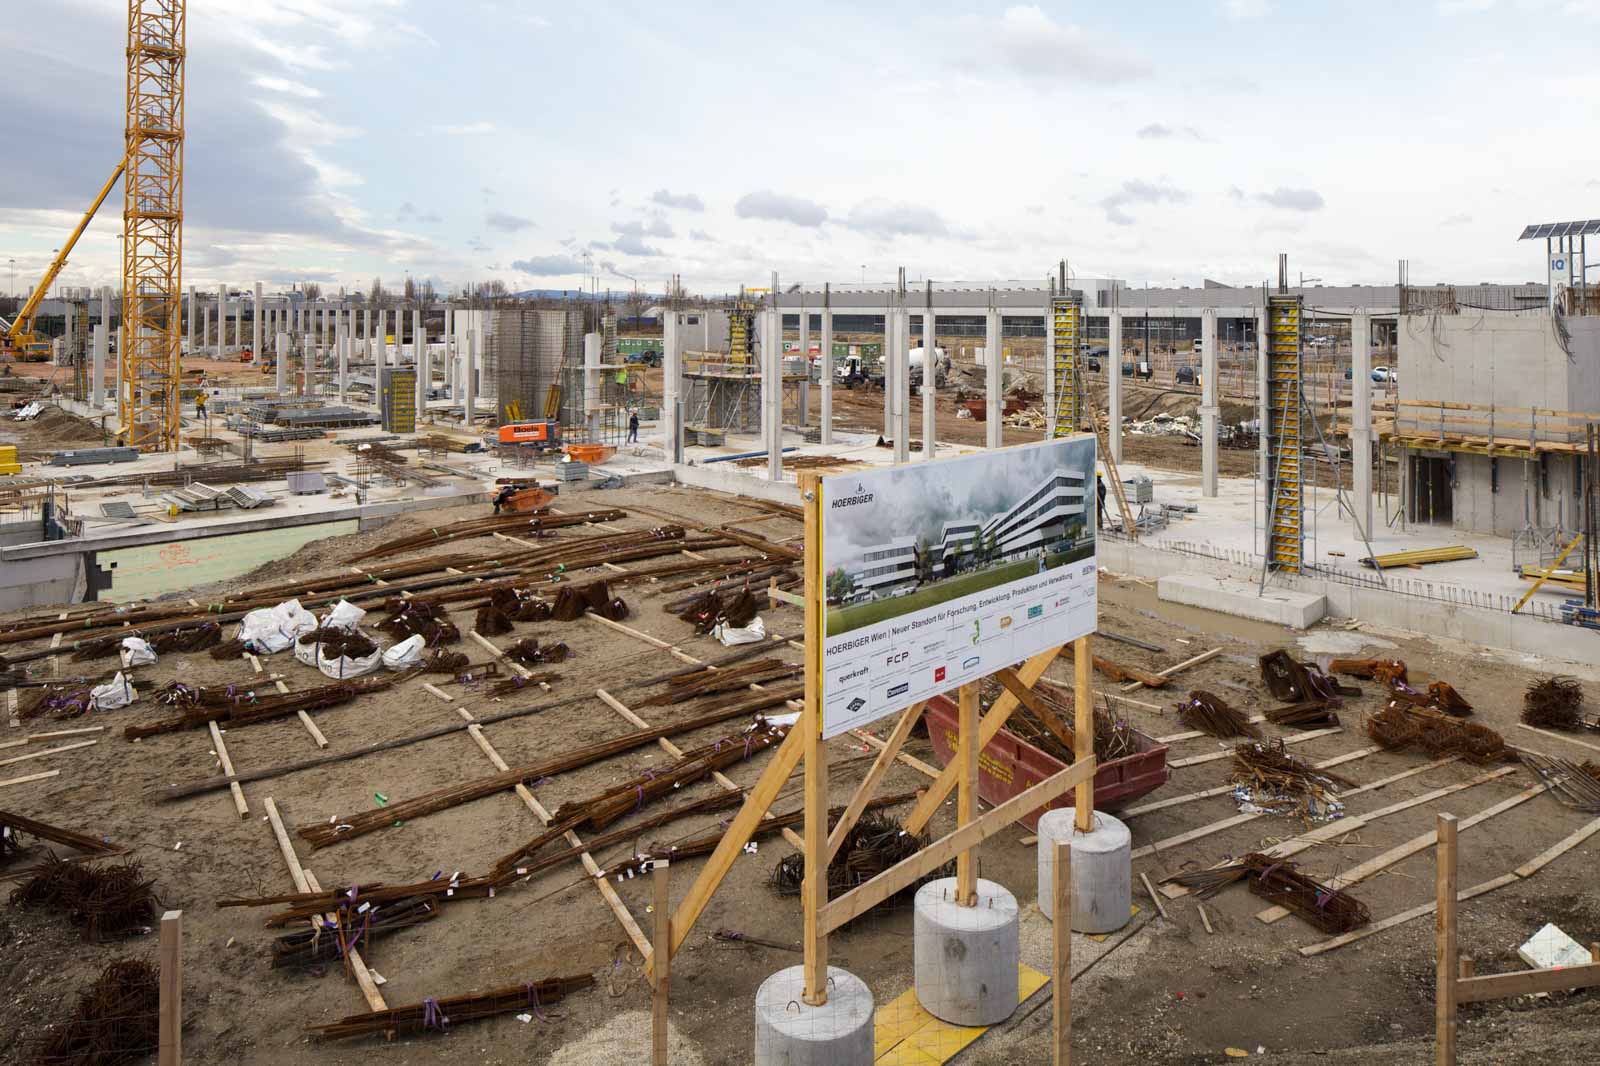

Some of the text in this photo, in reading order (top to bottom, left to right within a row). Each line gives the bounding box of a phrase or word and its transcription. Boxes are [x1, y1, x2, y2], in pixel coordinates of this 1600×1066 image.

[514, 425, 539, 433] Boels
[832, 493, 874, 509] HOERBIGER
[826, 636, 870, 657] HOERBIGER
[871, 631, 887, 643] Wien
[891, 623, 910, 636] Neuer
[911, 615, 937, 629] Standort
[937, 610, 946, 621] für
[1012, 583, 1039, 596] Produktion
[1039, 579, 1048, 589] und
[1048, 572, 1073, 585] Verwaltung
[886, 651, 909, 667] FCP
[838, 666, 869, 684] querkraft
